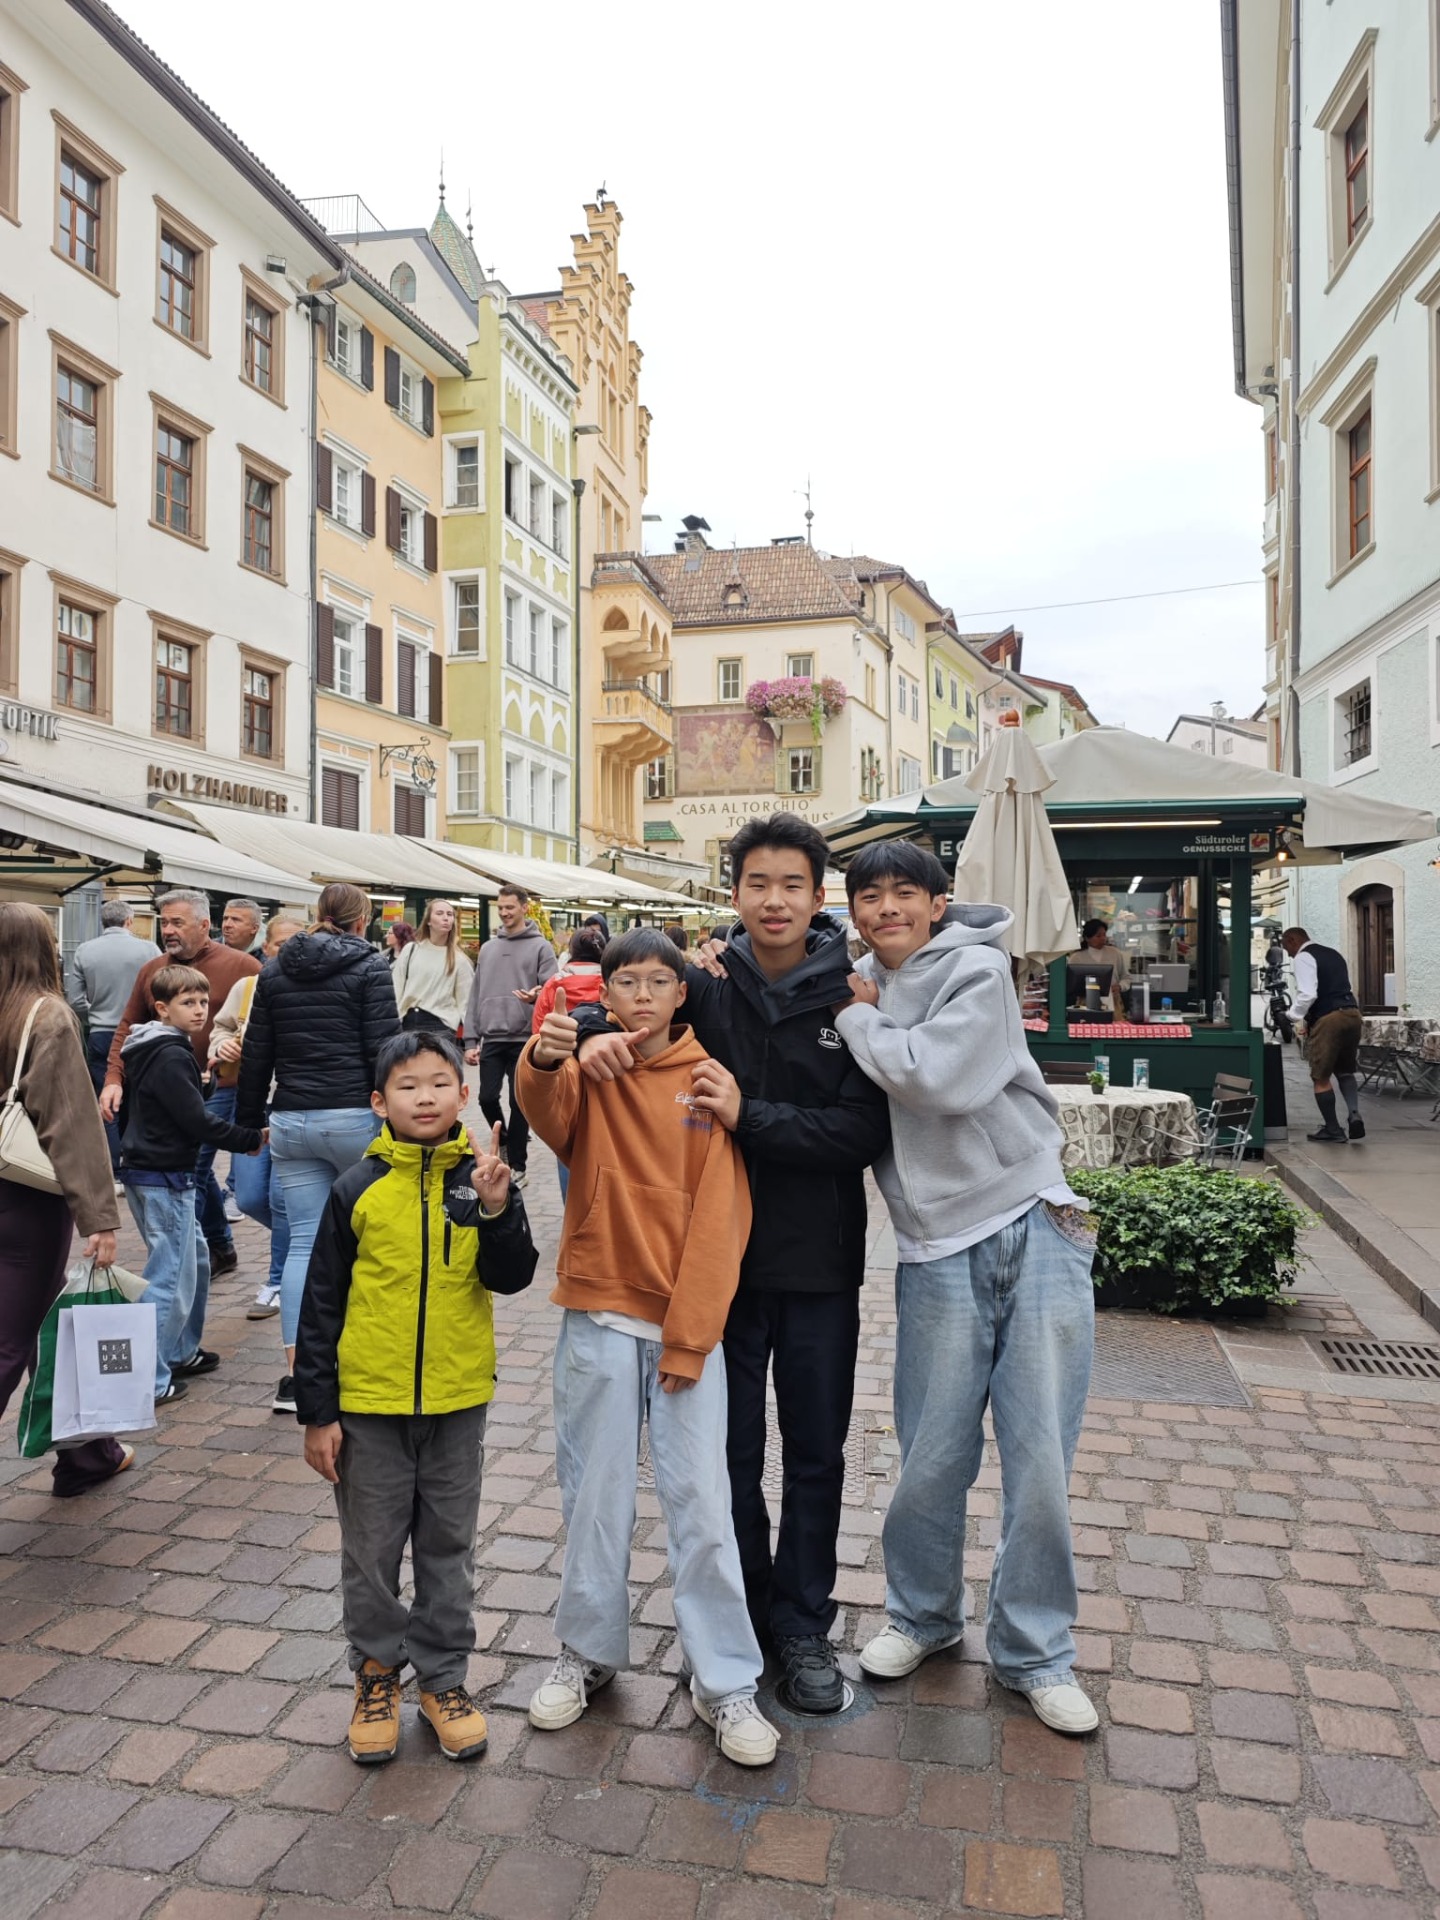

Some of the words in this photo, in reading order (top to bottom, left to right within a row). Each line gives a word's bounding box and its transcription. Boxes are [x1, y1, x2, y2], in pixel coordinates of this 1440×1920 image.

[6, 704, 61, 741] OPTIK
[147, 764, 288, 813] HOLZHAMMER
[721, 802, 739, 814] AL
[1182, 845, 1246, 853] GENUSSECKE
